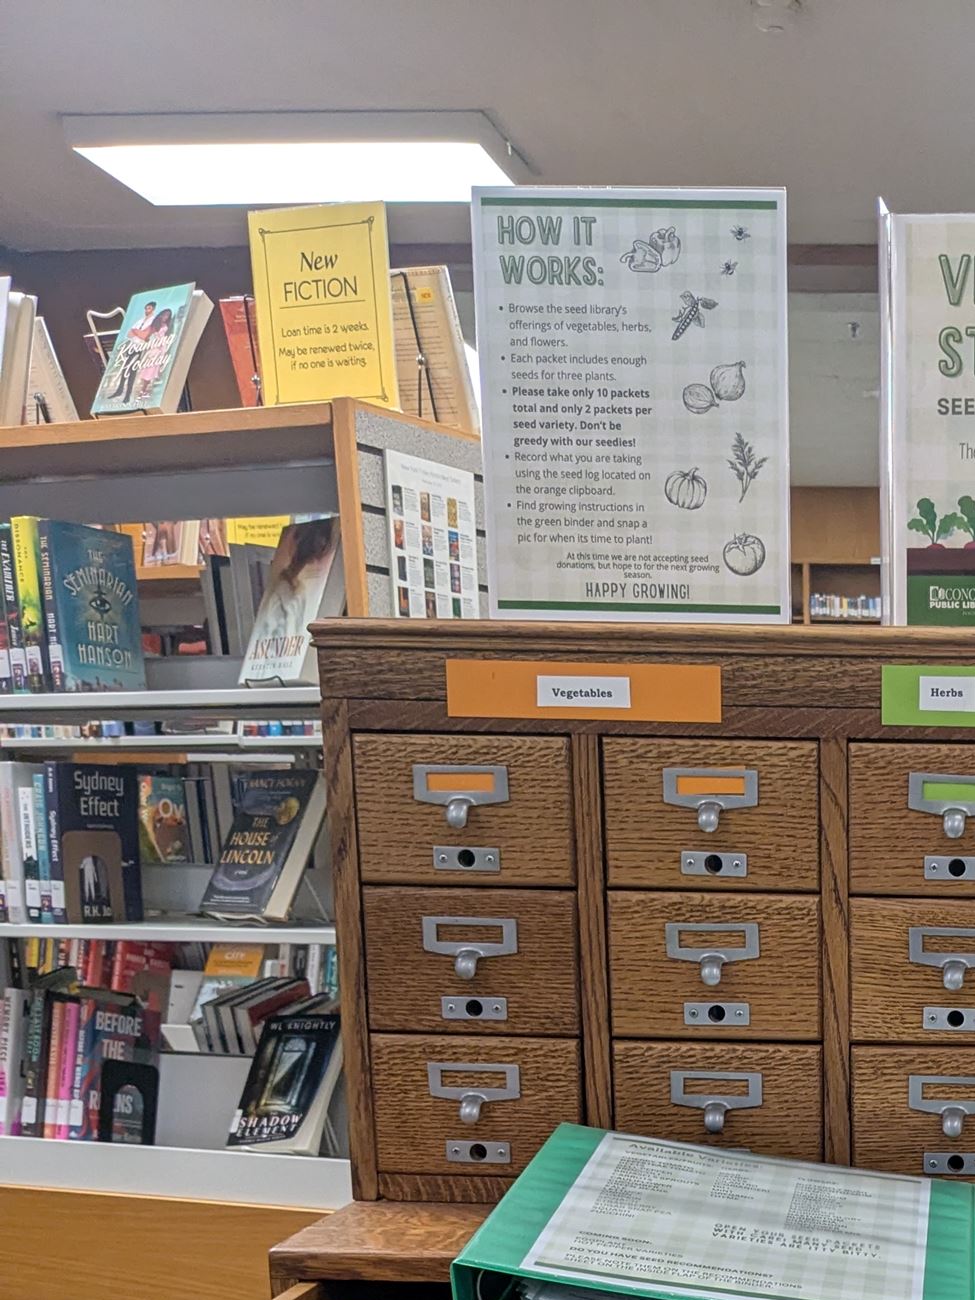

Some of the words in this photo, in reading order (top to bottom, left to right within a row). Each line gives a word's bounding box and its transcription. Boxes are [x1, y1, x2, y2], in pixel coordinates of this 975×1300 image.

[497, 215, 562, 245] HOW
[573, 216, 597, 246] IT
[300, 251, 338, 272] New
[499, 255, 605, 286] WORKS:
[284, 276, 358, 302] FICTION
[509, 303, 544, 315] Browse
[547, 303, 563, 314] the
[565, 303, 587, 315] seed
[590, 303, 627, 317] library's
[281, 327, 301, 338] Loan
[303, 324, 322, 335] time
[324, 324, 330, 334] is
[332, 324, 338, 334] 2
[340, 321, 369, 333] weeks.
[509, 319, 552, 332] offerings
[554, 320, 564, 331] of
[566, 320, 619, 334] vegetables,
[622, 321, 652, 334] herbs,
[114, 334, 176, 362] Roaming
[510, 336, 527, 347] and
[530, 336, 568, 348] flowers.
[279, 346, 295, 358] May
[297, 345, 307, 355] be
[309, 345, 347, 355] renewed
[349, 342, 375, 352] twice,
[113, 352, 172, 382] Holiday
[291, 360, 297, 371] if
[299, 361, 308, 369] no
[310, 360, 325, 368] one
[327, 359, 334, 367] is
[336, 357, 367, 367] waiting.
[511, 353, 533, 364] Each
[535, 353, 567, 367] packet
[570, 353, 608, 365] includes
[611, 354, 647, 367] enough
[512, 369, 539, 380] seeds
[541, 369, 555, 380] for
[557, 369, 582, 380] three
[585, 370, 616, 383] plants.
[512, 386, 544, 397] Please
[547, 386, 570, 397] take
[573, 386, 594, 401] only
[597, 387, 608, 398] 10
[611, 387, 650, 401] packets
[513, 402, 537, 413] total
[540, 402, 559, 414] and
[561, 403, 583, 416] only
[585, 404, 591, 414] 2
[593, 403, 633, 417] packets
[635, 406, 652, 417] per
[513, 419, 536, 430] seed
[539, 419, 577, 432] variety.
[580, 419, 606, 431] Don't
[609, 420, 621, 431] be
[514, 435, 548, 449] greedy
[550, 435, 573, 447] with
[576, 438, 593, 447] our
[596, 436, 636, 448] seedies!
[515, 451, 547, 462] Record
[550, 452, 573, 463] what
[575, 454, 590, 465] you
[593, 454, 611, 463] are
[613, 452, 642, 465] taking
[515, 468, 540, 481] using
[543, 468, 558, 479] the
[561, 468, 582, 479] seed
[585, 468, 599, 482] log
[602, 469, 636, 480] located
[638, 471, 651, 480] on
[516, 484, 531, 495] the
[534, 486, 566, 498] orange
[569, 484, 615, 498] clipboard.
[517, 500, 536, 511] Find
[539, 501, 576, 514] growing
[579, 501, 633, 512] instructions
[636, 502, 644, 512] in
[517, 516, 532, 527] the
[535, 518, 561, 530] green
[564, 516, 594, 528] binder
[597, 517, 615, 528] and
[617, 519, 639, 530] snap
[642, 519, 648, 528] a
[518, 532, 531, 546] pic
[534, 532, 547, 543] for
[550, 532, 575, 544] when
[578, 532, 588, 544] its
[590, 533, 611, 544] time
[614, 533, 624, 544] to
[627, 533, 652, 547] plant!
[63, 566, 133, 606] SEMINARIAN
[585, 582, 627, 598] HAPPY
[633, 583, 689, 599] GROWING!
[87, 621, 119, 643] HART
[78, 643, 133, 669] HANSON
[552, 688, 613, 699] Vegetables
[930, 688, 963, 697] Herbs
[74, 770, 124, 796] Sydney
[80, 797, 120, 817] Effect
[230, 831, 271, 846] HOUSE
[220, 850, 275, 864] LINCOLN
[96, 1011, 143, 1036] BEFORE
[102, 1039, 125, 1060] THE
[239, 1114, 302, 1129] SHADOW
[236, 1123, 298, 1137] ELEMENT
